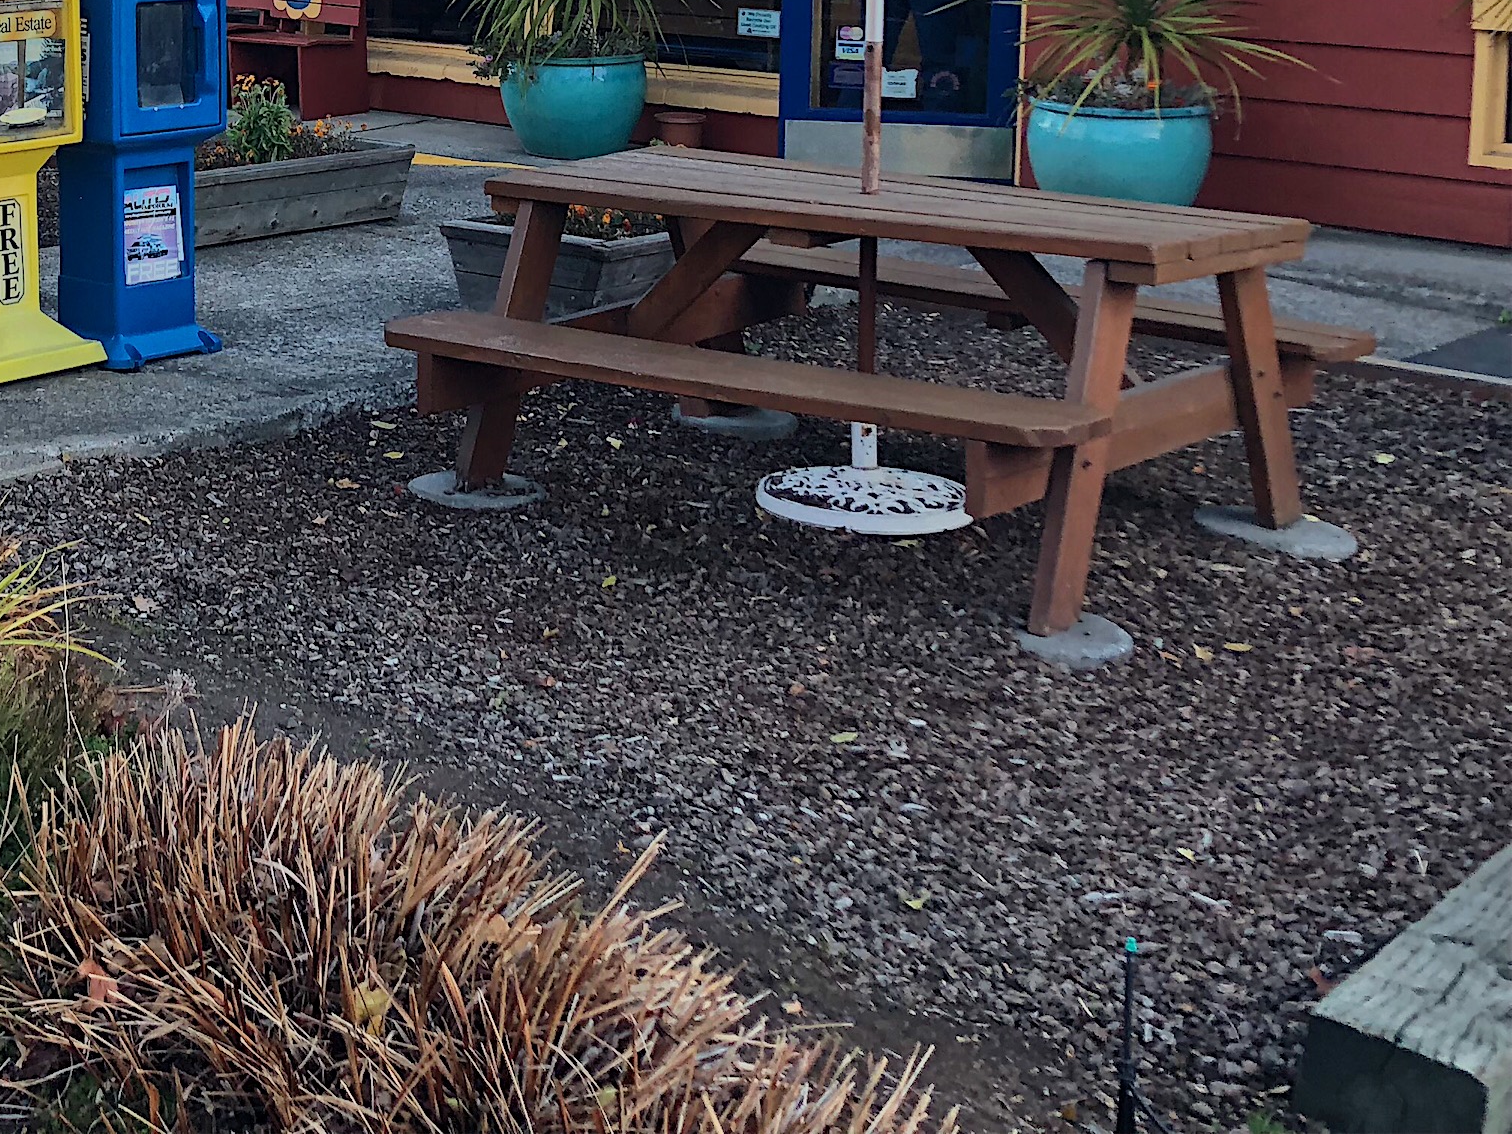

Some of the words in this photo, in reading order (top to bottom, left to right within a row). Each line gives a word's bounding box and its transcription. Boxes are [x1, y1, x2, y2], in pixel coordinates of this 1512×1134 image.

[15, 16, 52, 33] Estate
[124, 188, 171, 210] AUTO
[128, 260, 179, 284] FREE
